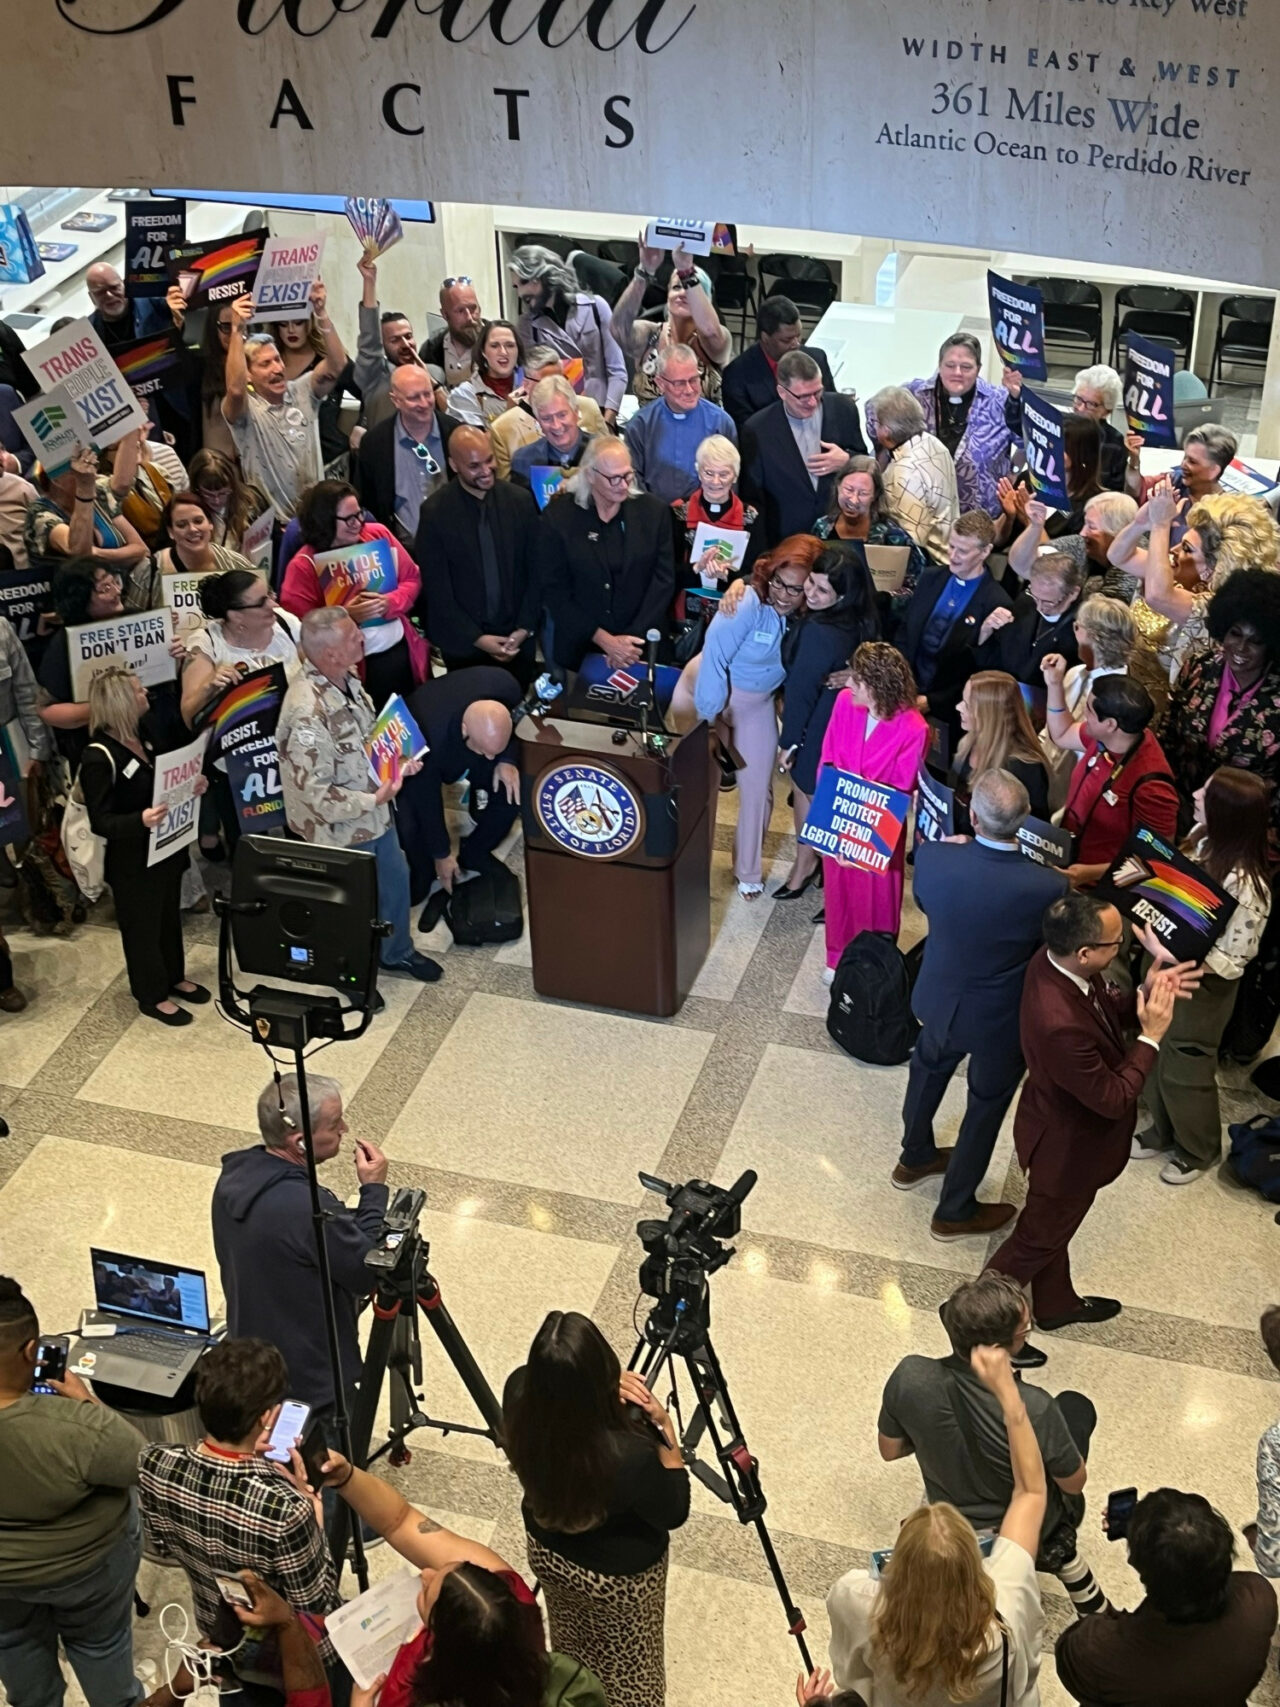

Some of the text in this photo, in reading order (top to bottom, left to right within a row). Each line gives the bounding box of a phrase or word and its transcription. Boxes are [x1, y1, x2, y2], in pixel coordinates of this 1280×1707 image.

[903, 37, 1241, 89] WIDTH EAST & WEST
[166, 75, 635, 149] FACTS
[931, 82, 1200, 140] 361 Miles Wide
[875, 122, 1251, 187] Atlantic Ocean to Perdido River
[131, 214, 182, 227] FREEDOM
[147, 231, 168, 242] FOR
[131, 245, 165, 270] AL
[270, 244, 318, 267] TRANS
[208, 281, 247, 301] RESIST.
[258, 281, 312, 303] EXIST
[991, 286, 1037, 314] FREEDOM
[1003, 308, 1022, 325] FOR
[995, 320, 1039, 354] ALL
[39, 337, 98, 383] TRANS
[1128, 348, 1170, 377] FREEDOM
[64, 357, 113, 400] EOPLE
[131, 378, 163, 396] ESIST.
[1136, 371, 1154, 389] FOR
[76, 378, 125, 424] XIST
[1125, 385, 1168, 420] ALL
[1024, 402, 1061, 438] FREEDOM
[1032, 428, 1048, 448] FOR
[1026, 441, 1061, 482] ALL
[328, 551, 382, 577] PRIDE
[337, 566, 385, 588] CAPITOL
[0, 581, 50, 600] REEDOM
[173, 580, 202, 592] FRE
[8, 601, 35, 616] FOR
[80, 617, 164, 645] FREE STATES
[81, 630, 165, 660] DON'T BAN
[585, 683, 642, 708] sav
[220, 720, 261, 750] RESIST.
[232, 736, 277, 756] FREED
[371, 711, 406, 756] PRIDE
[162, 753, 201, 791] TRANS
[253, 751, 279, 768] FOR
[240, 768, 283, 802] AL
[554, 768, 619, 792] SENATE
[836, 777, 891, 810] PROMOTE
[156, 799, 196, 839] EXIST
[242, 800, 284, 818] FLORID
[542, 793, 636, 852] STATE OF FLORIDA
[832, 796, 883, 827] PROTECT
[830, 815, 873, 843] DEFEND
[1015, 827, 1064, 858] EEDOM
[800, 823, 890, 871] LGBTQ EQUALITY
[1021, 844, 1046, 865] FOR
[1131, 898, 1178, 940] RESIST.
